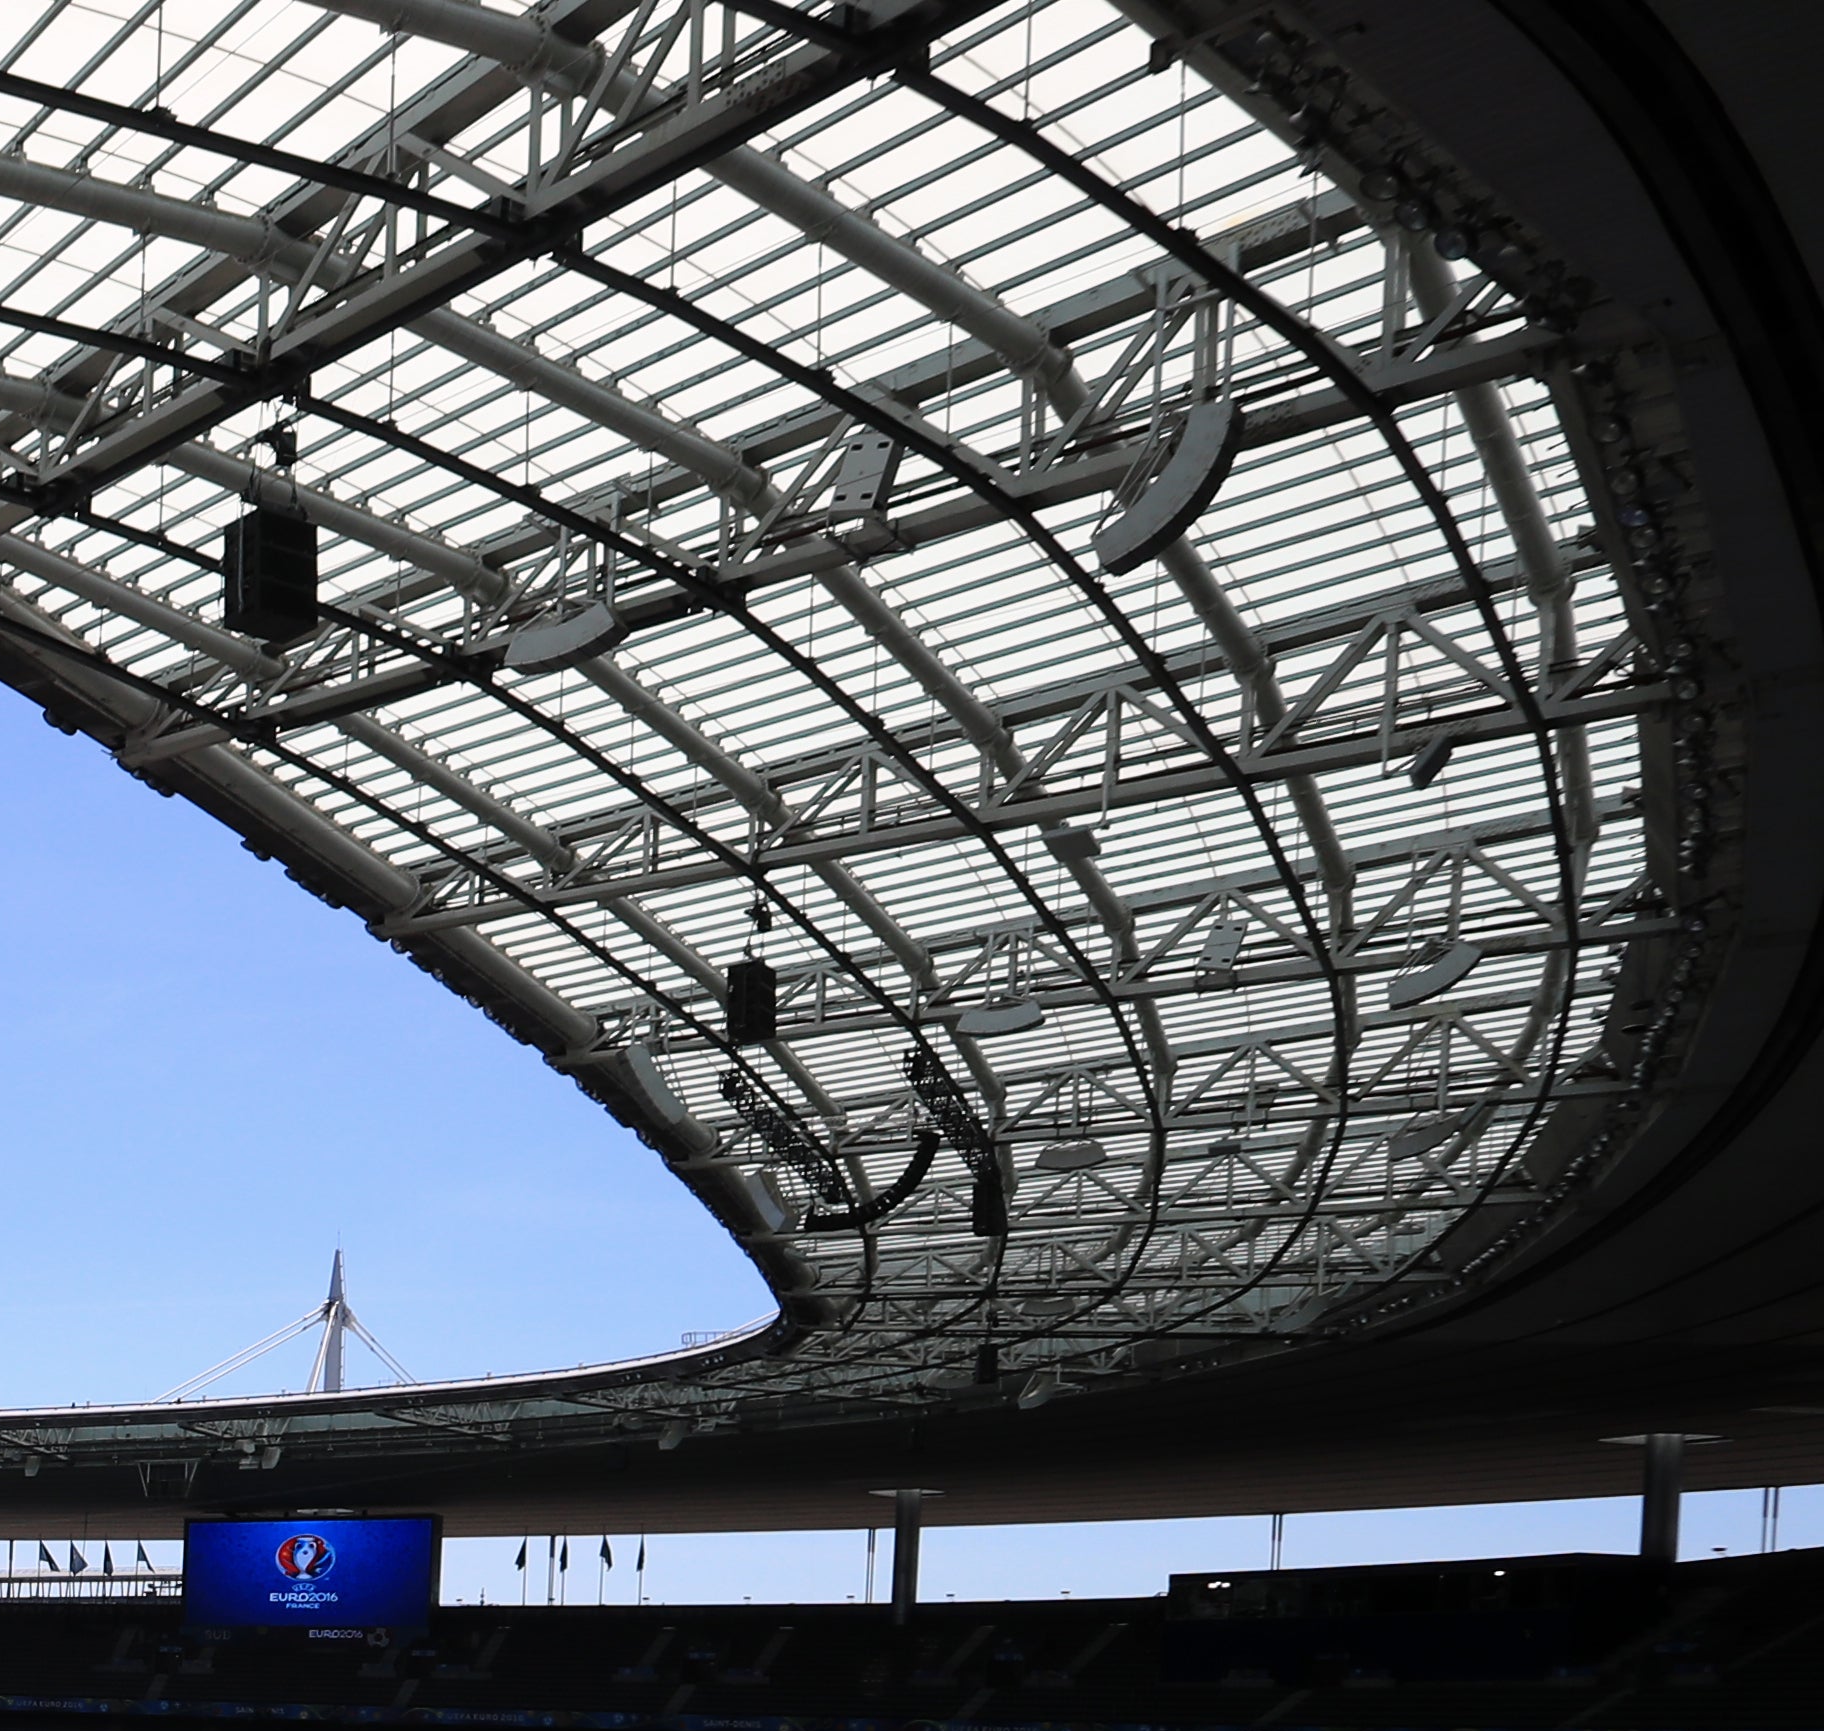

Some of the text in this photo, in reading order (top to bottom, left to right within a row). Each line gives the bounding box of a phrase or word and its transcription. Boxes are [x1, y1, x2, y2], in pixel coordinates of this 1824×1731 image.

[269, 1591, 339, 1603] EURO2016
[308, 1628, 364, 1639] EURO2016
[473, 1712, 500, 1721] EURO
